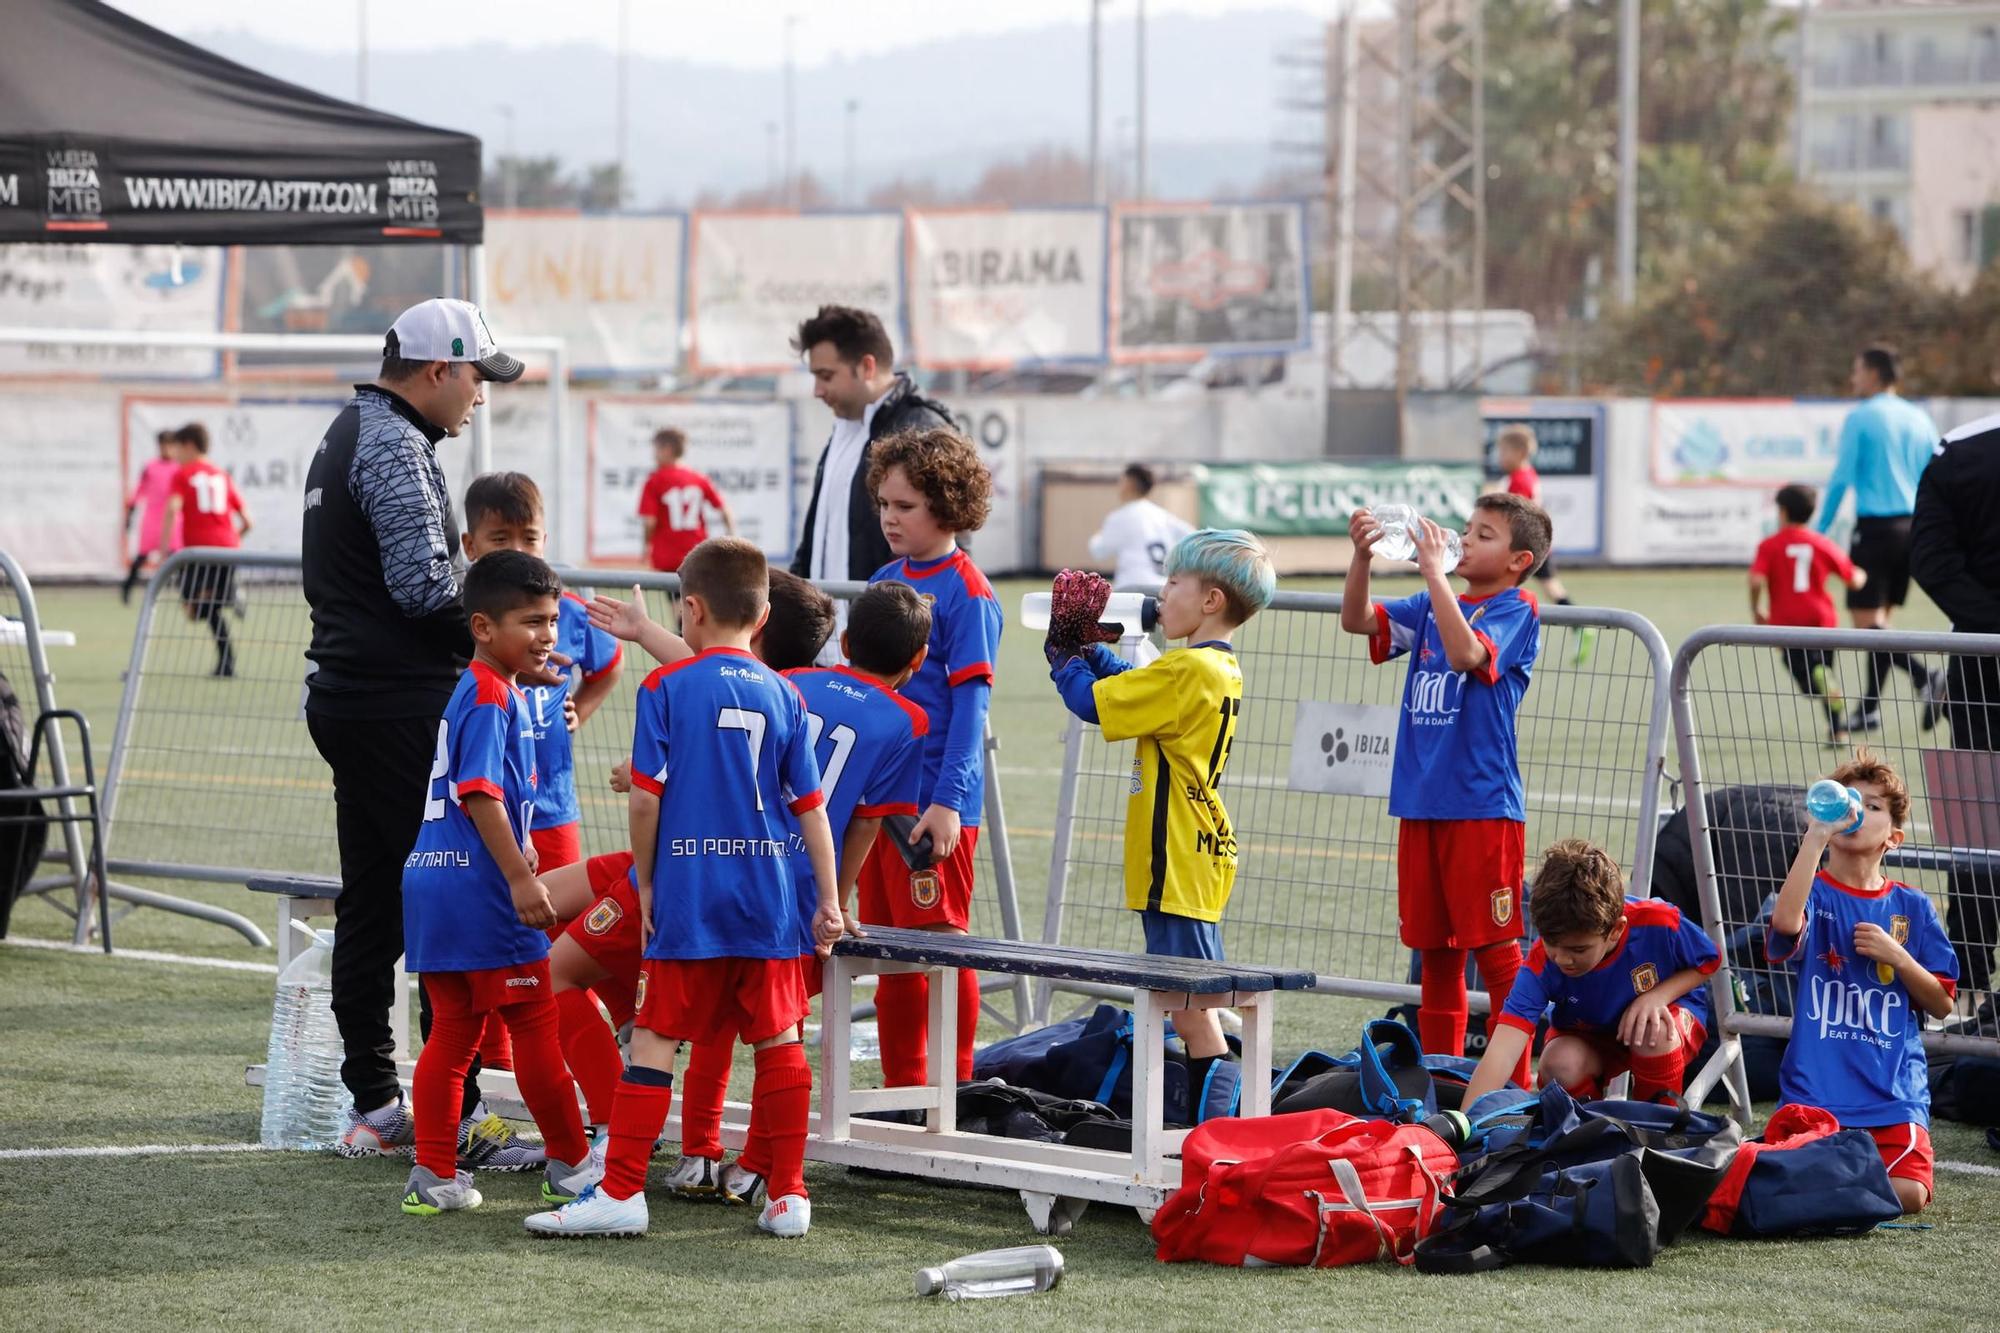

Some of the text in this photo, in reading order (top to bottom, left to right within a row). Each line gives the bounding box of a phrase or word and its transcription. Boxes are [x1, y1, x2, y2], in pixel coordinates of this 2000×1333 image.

[47, 168, 100, 188] IBIZA
[388, 177, 438, 197] IBIZA
[47, 188, 101, 215] MTB
[387, 196, 439, 221] MTB
[189, 470, 228, 515] 11
[1785, 542, 1814, 593] 7
[1354, 733, 1390, 756] IBIZA
[716, 706, 766, 812] 7
[1829, 1029, 1893, 1050] EAT & DANCE
